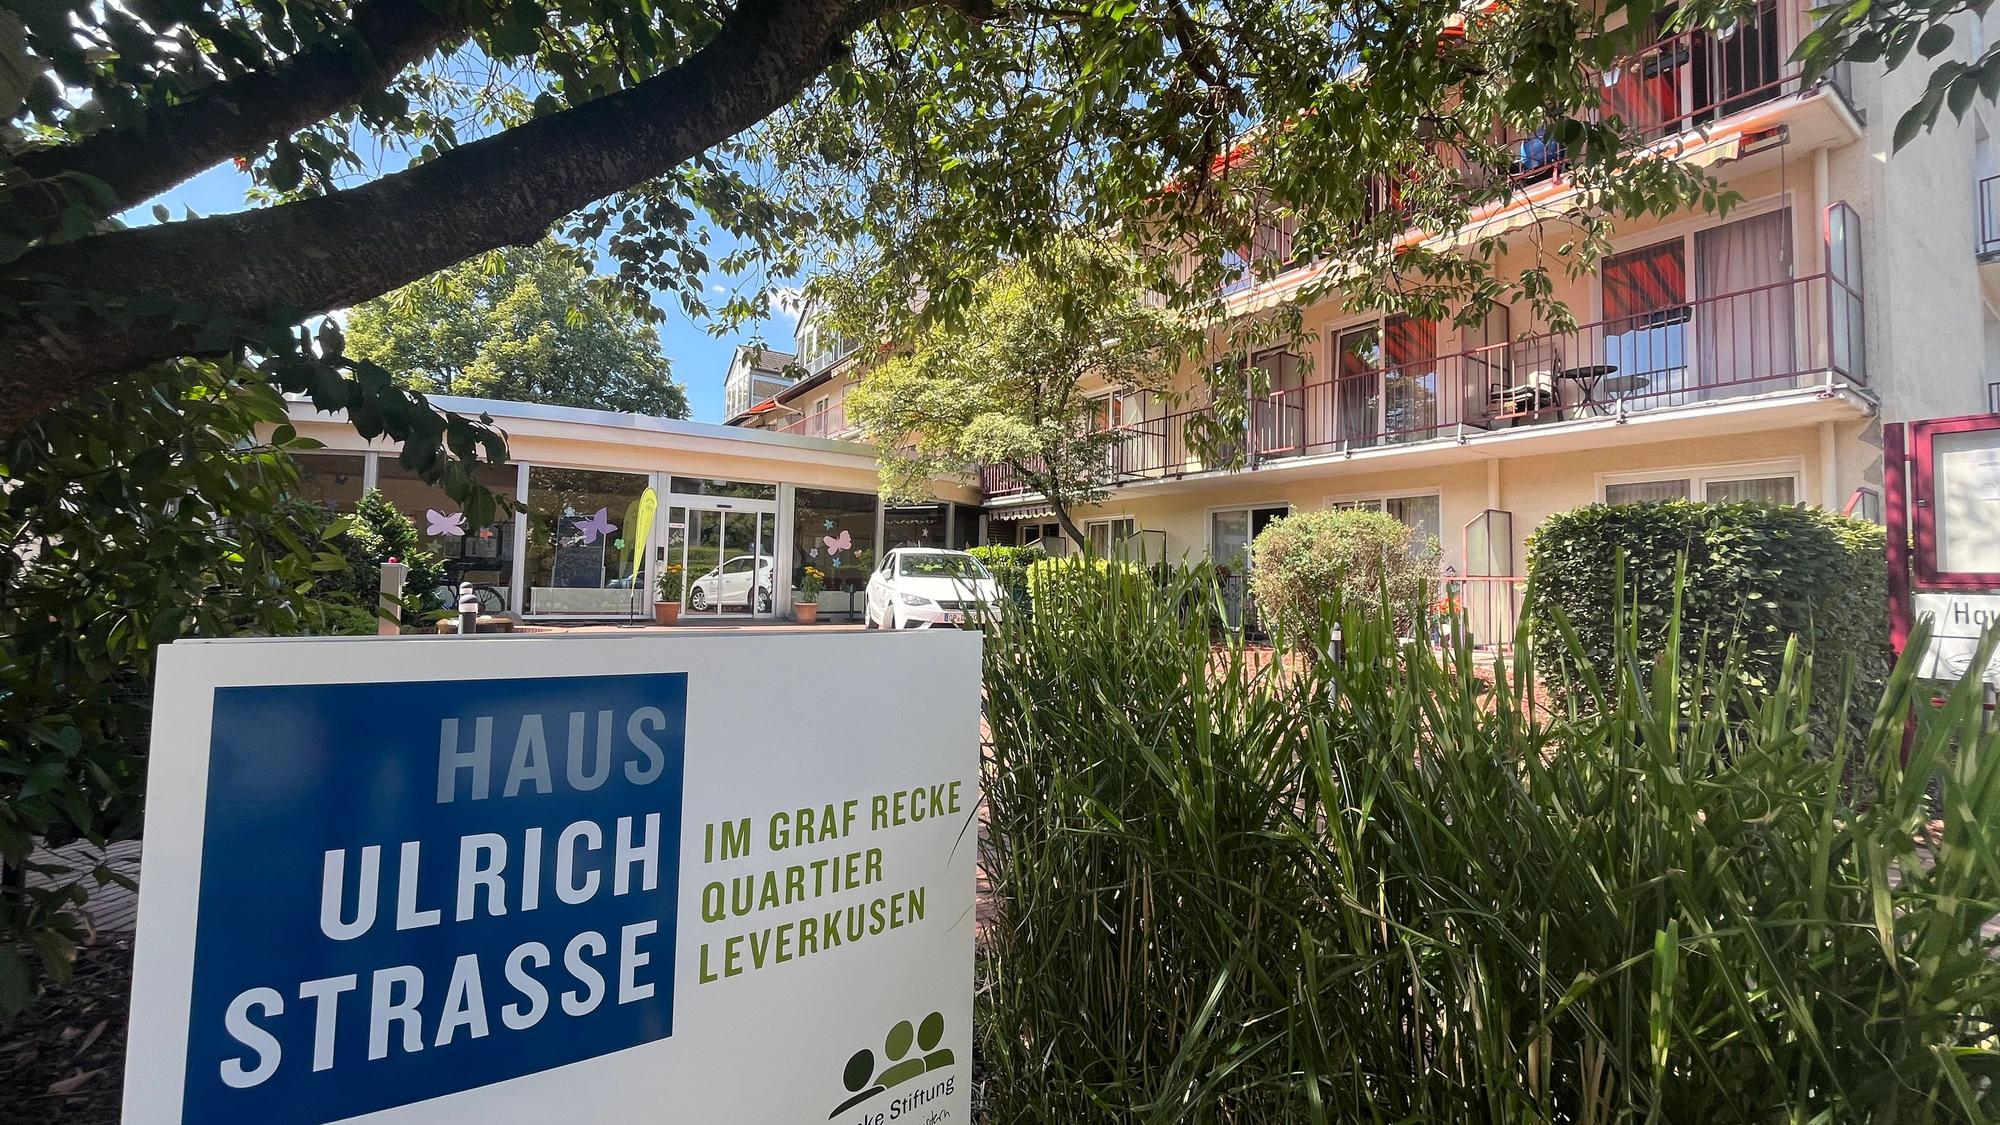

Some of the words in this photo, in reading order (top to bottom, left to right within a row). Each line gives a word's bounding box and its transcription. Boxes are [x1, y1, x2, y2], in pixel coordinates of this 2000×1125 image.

[436, 706, 666, 804] HAUS
[704, 817, 751, 864] IM
[768, 799, 858, 852] GRAF
[871, 780, 962, 831] RECKE
[320, 812, 661, 941] ULRICH
[701, 847, 883, 924] QUARTIER
[699, 886, 925, 985] LEVERKUSEN
[219, 919, 659, 1090] STRASSE
[856, 1113, 884, 1125] ke
[889, 1075, 955, 1120] Stiftung
